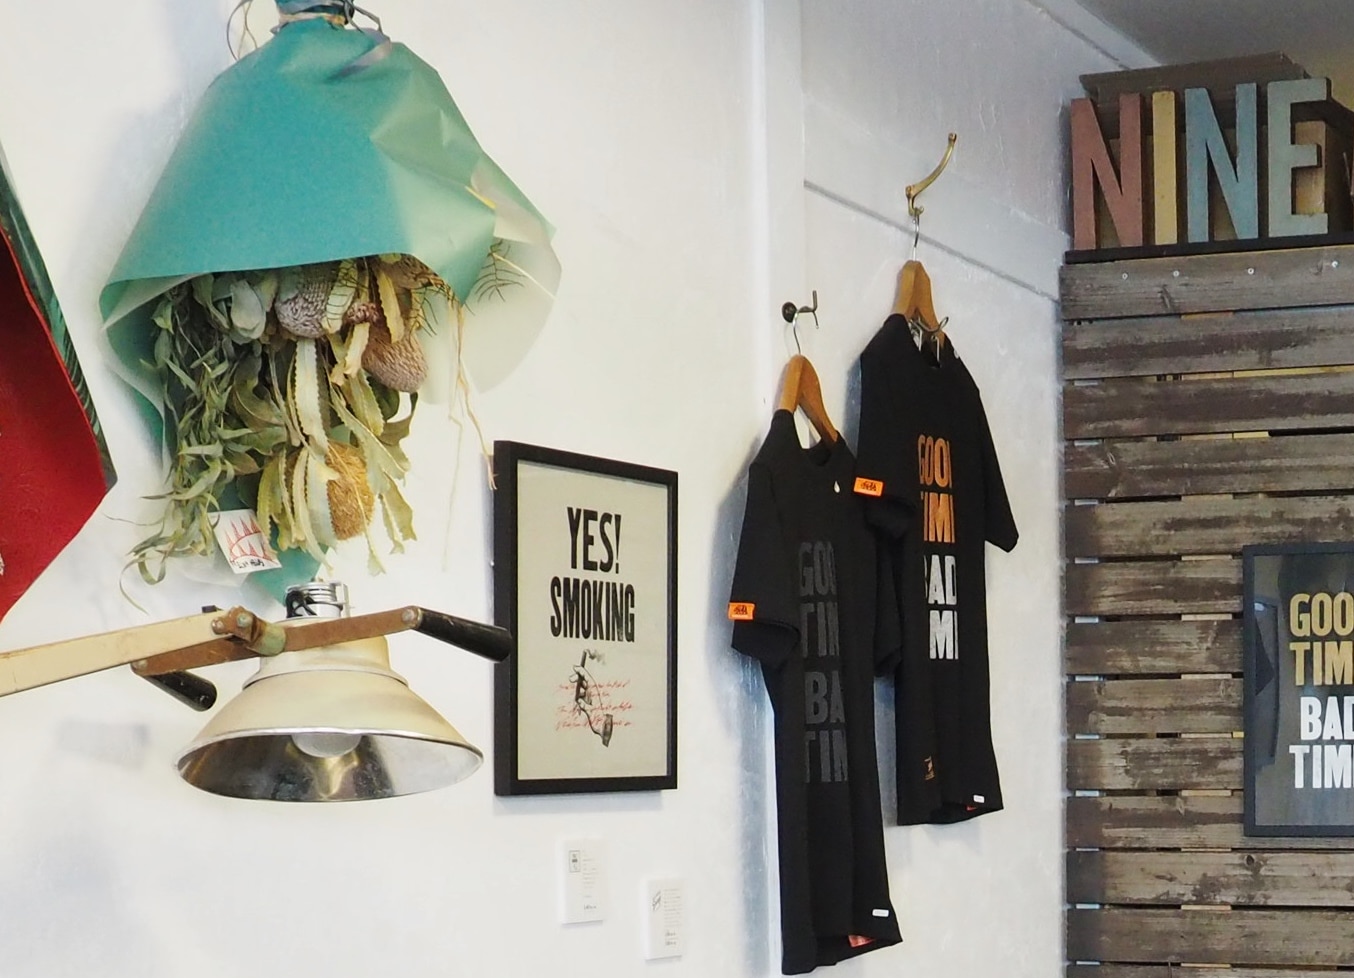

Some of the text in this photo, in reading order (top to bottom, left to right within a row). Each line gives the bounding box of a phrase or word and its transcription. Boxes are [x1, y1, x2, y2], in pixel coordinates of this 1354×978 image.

[1072, 78, 1330, 251] NINE
[566, 506, 622, 574] YES!
[550, 575, 636, 643] SMOKING
